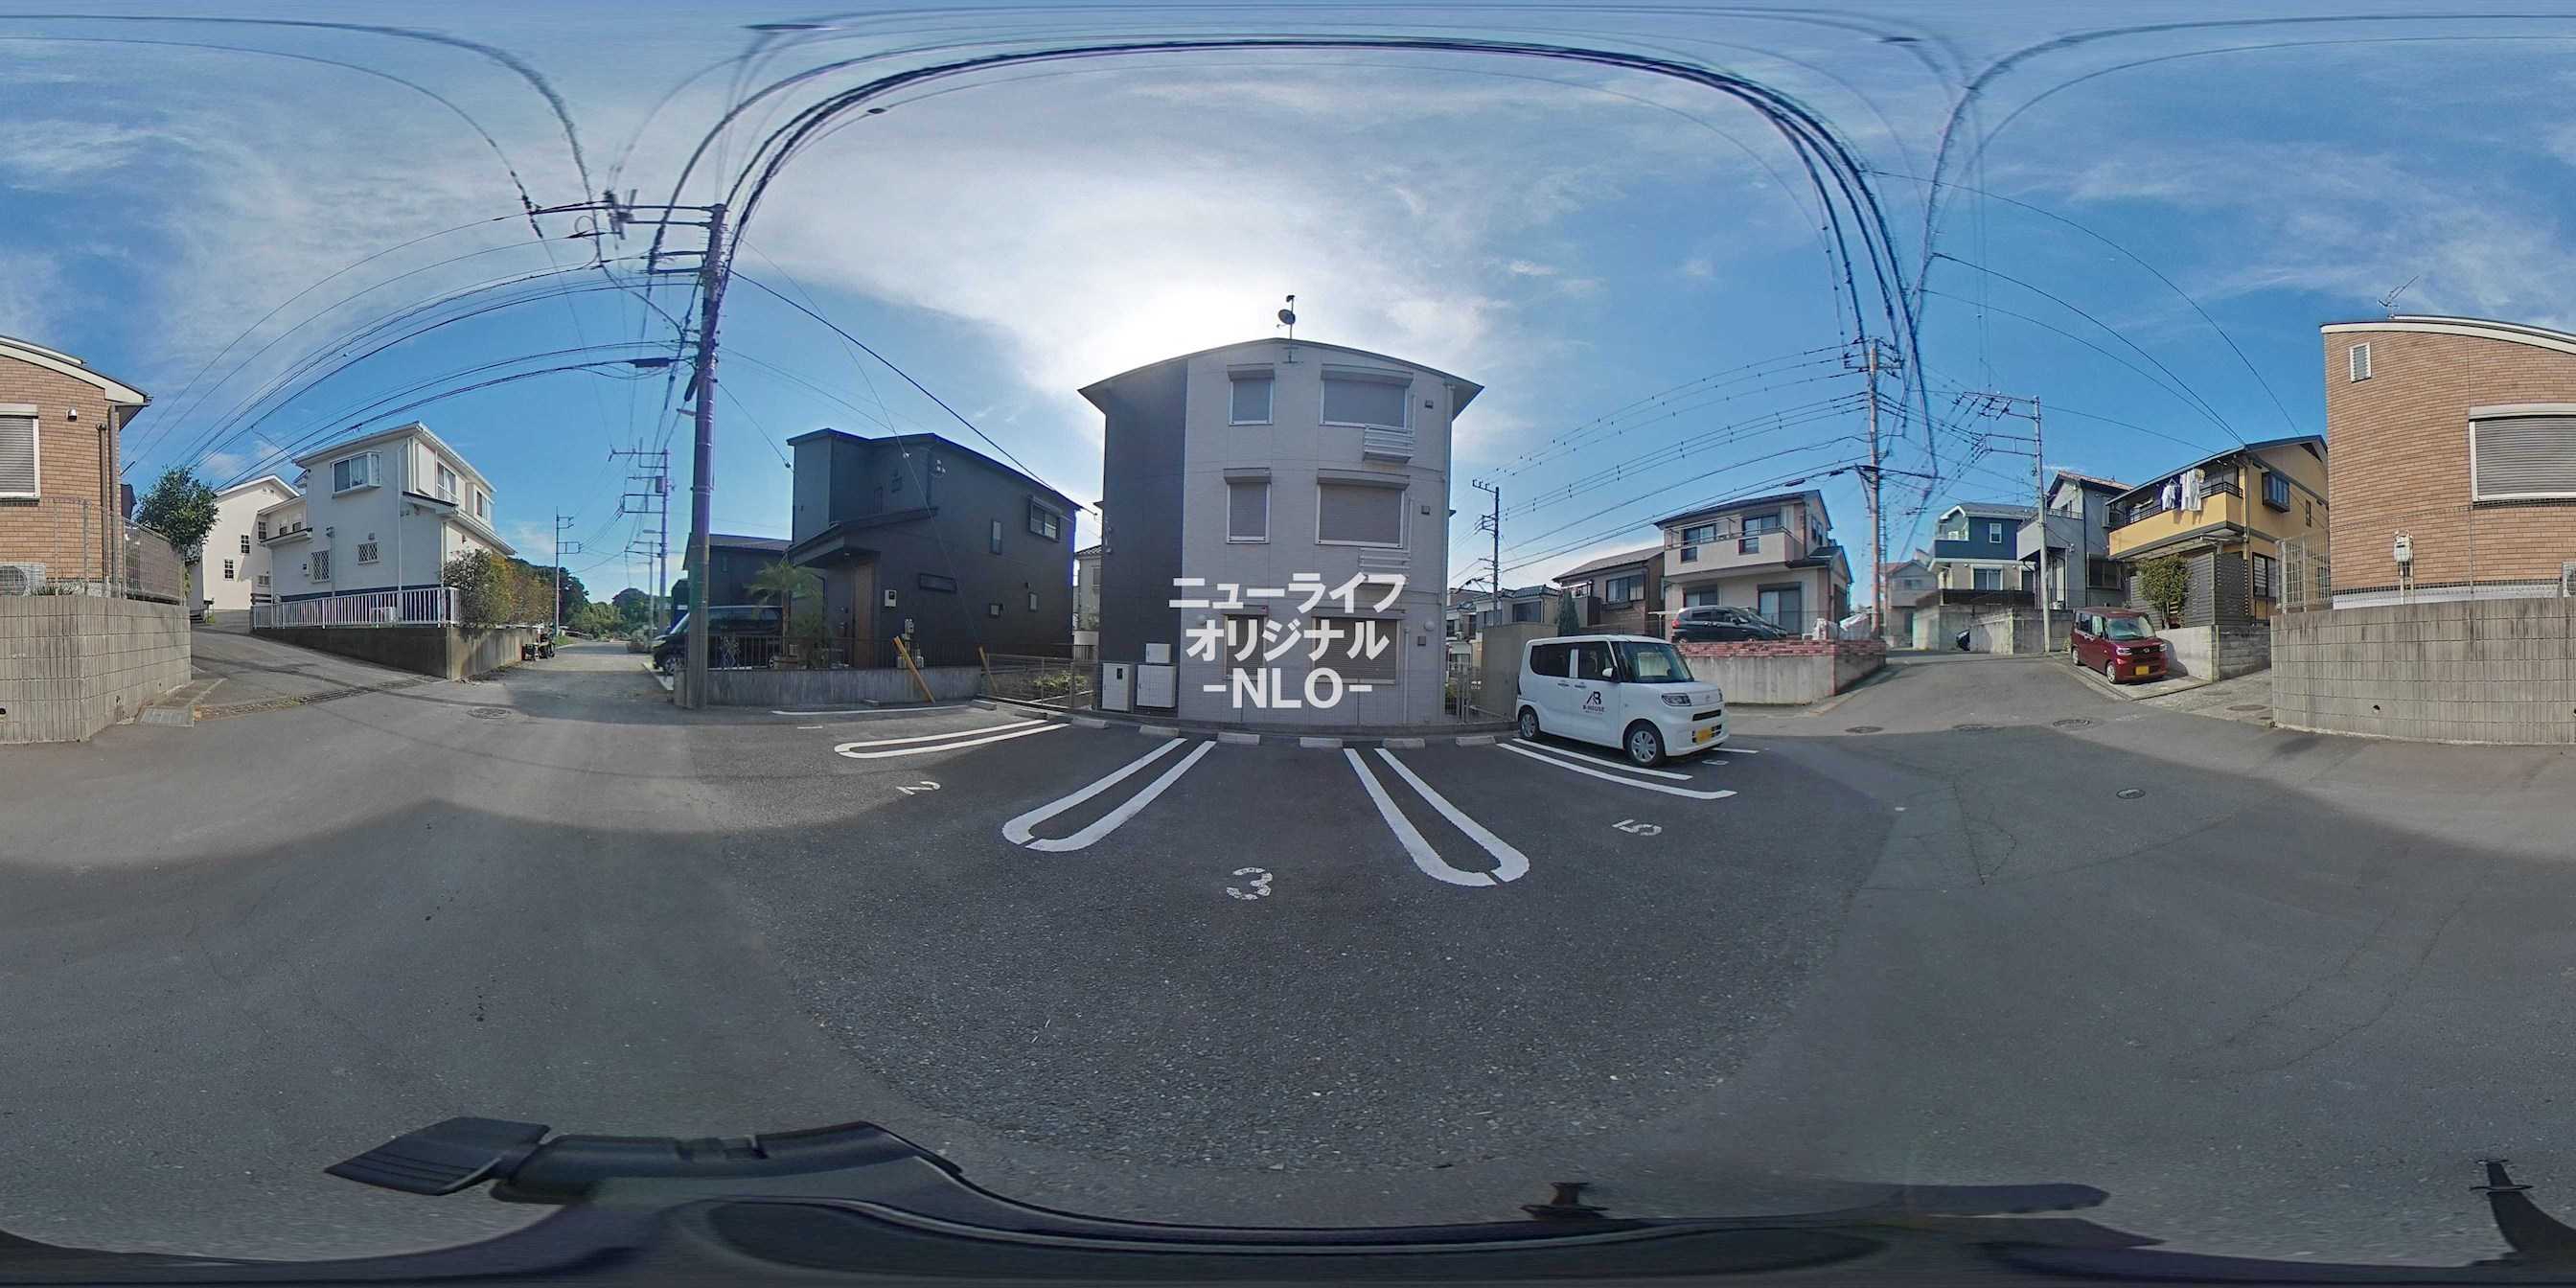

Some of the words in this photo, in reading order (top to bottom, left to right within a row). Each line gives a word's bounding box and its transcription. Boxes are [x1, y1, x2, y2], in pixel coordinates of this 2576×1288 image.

[895, 781, 940, 795] 2
[1612, 818, 1662, 836] 5
[1227, 867, 1273, 900] 3
